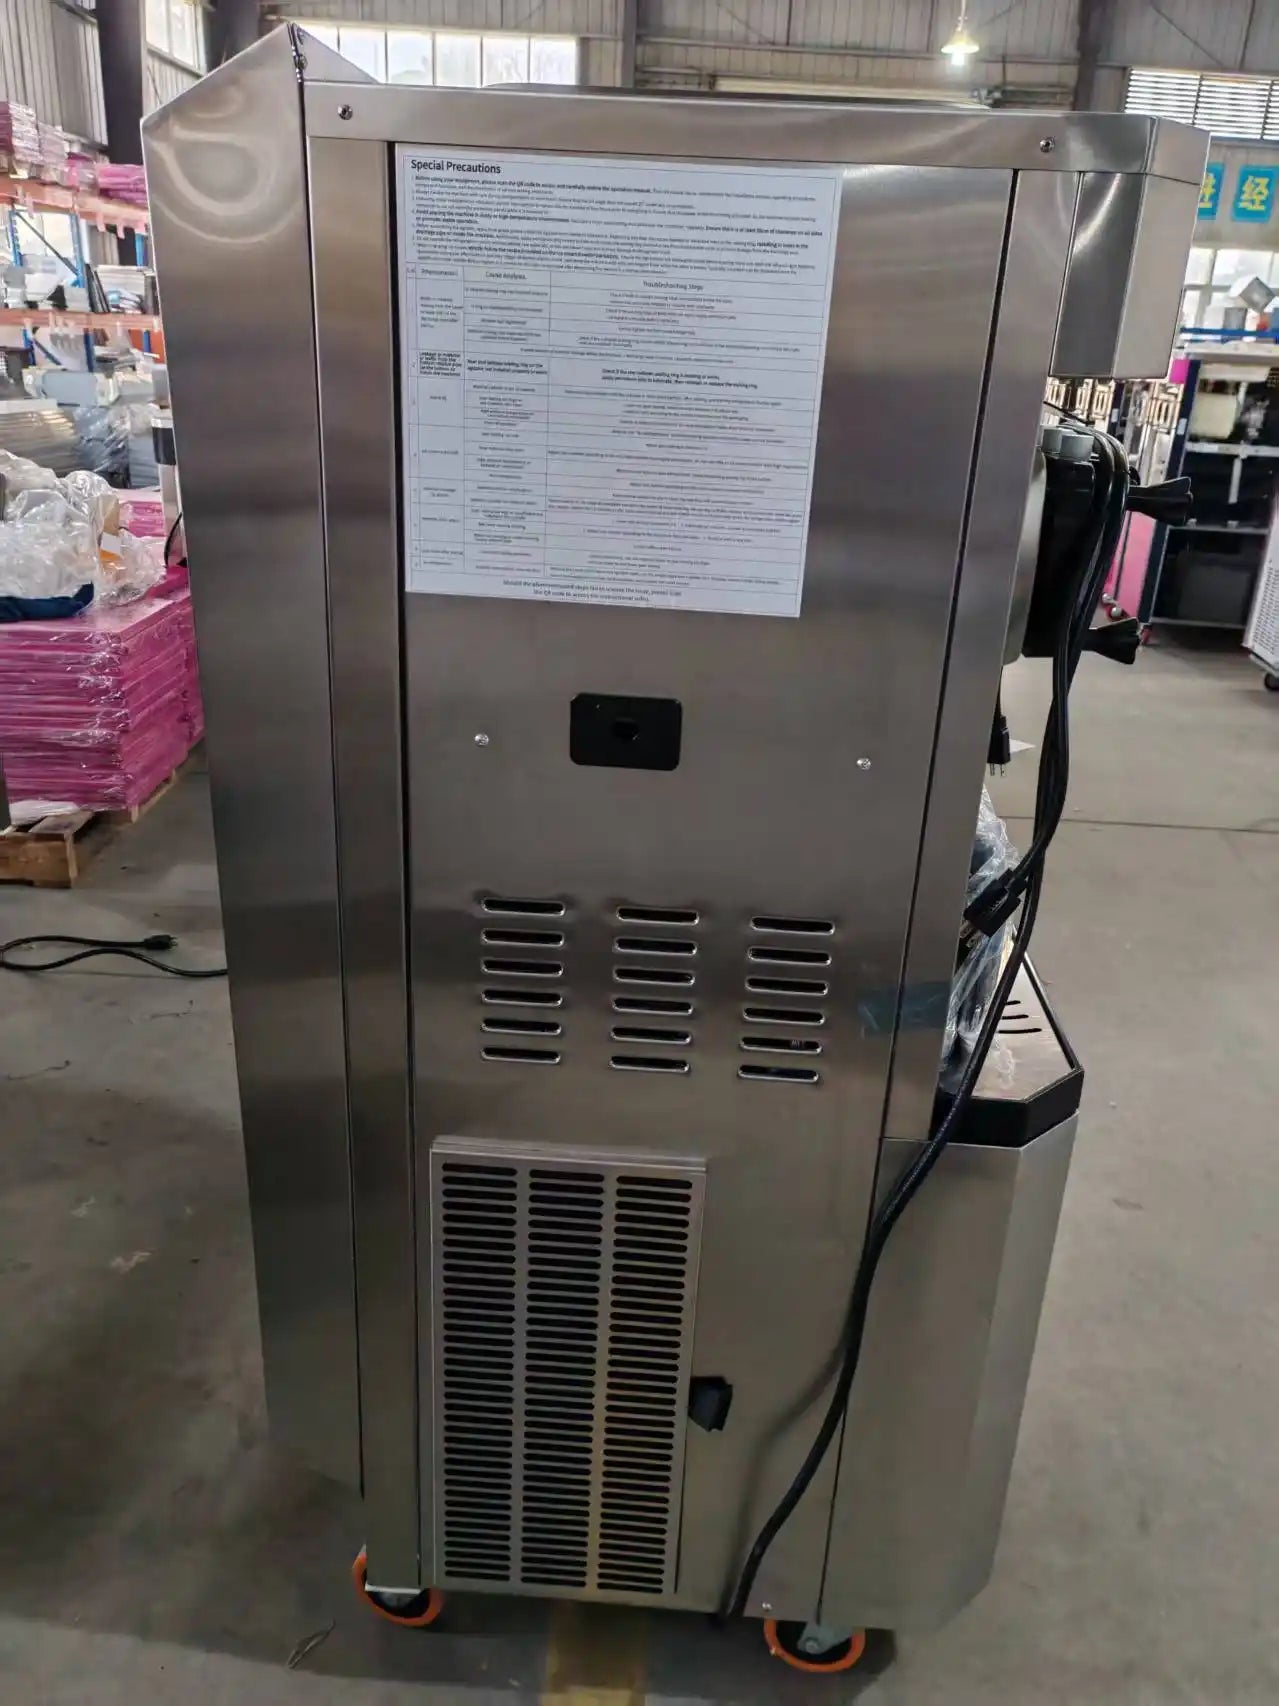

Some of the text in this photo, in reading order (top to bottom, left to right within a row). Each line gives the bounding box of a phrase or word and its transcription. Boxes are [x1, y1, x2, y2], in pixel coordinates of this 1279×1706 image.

[411, 160, 501, 173] Special Precautions
[1239, 175, 1269, 211] 经
[643, 280, 687, 290] Troubleshooting
